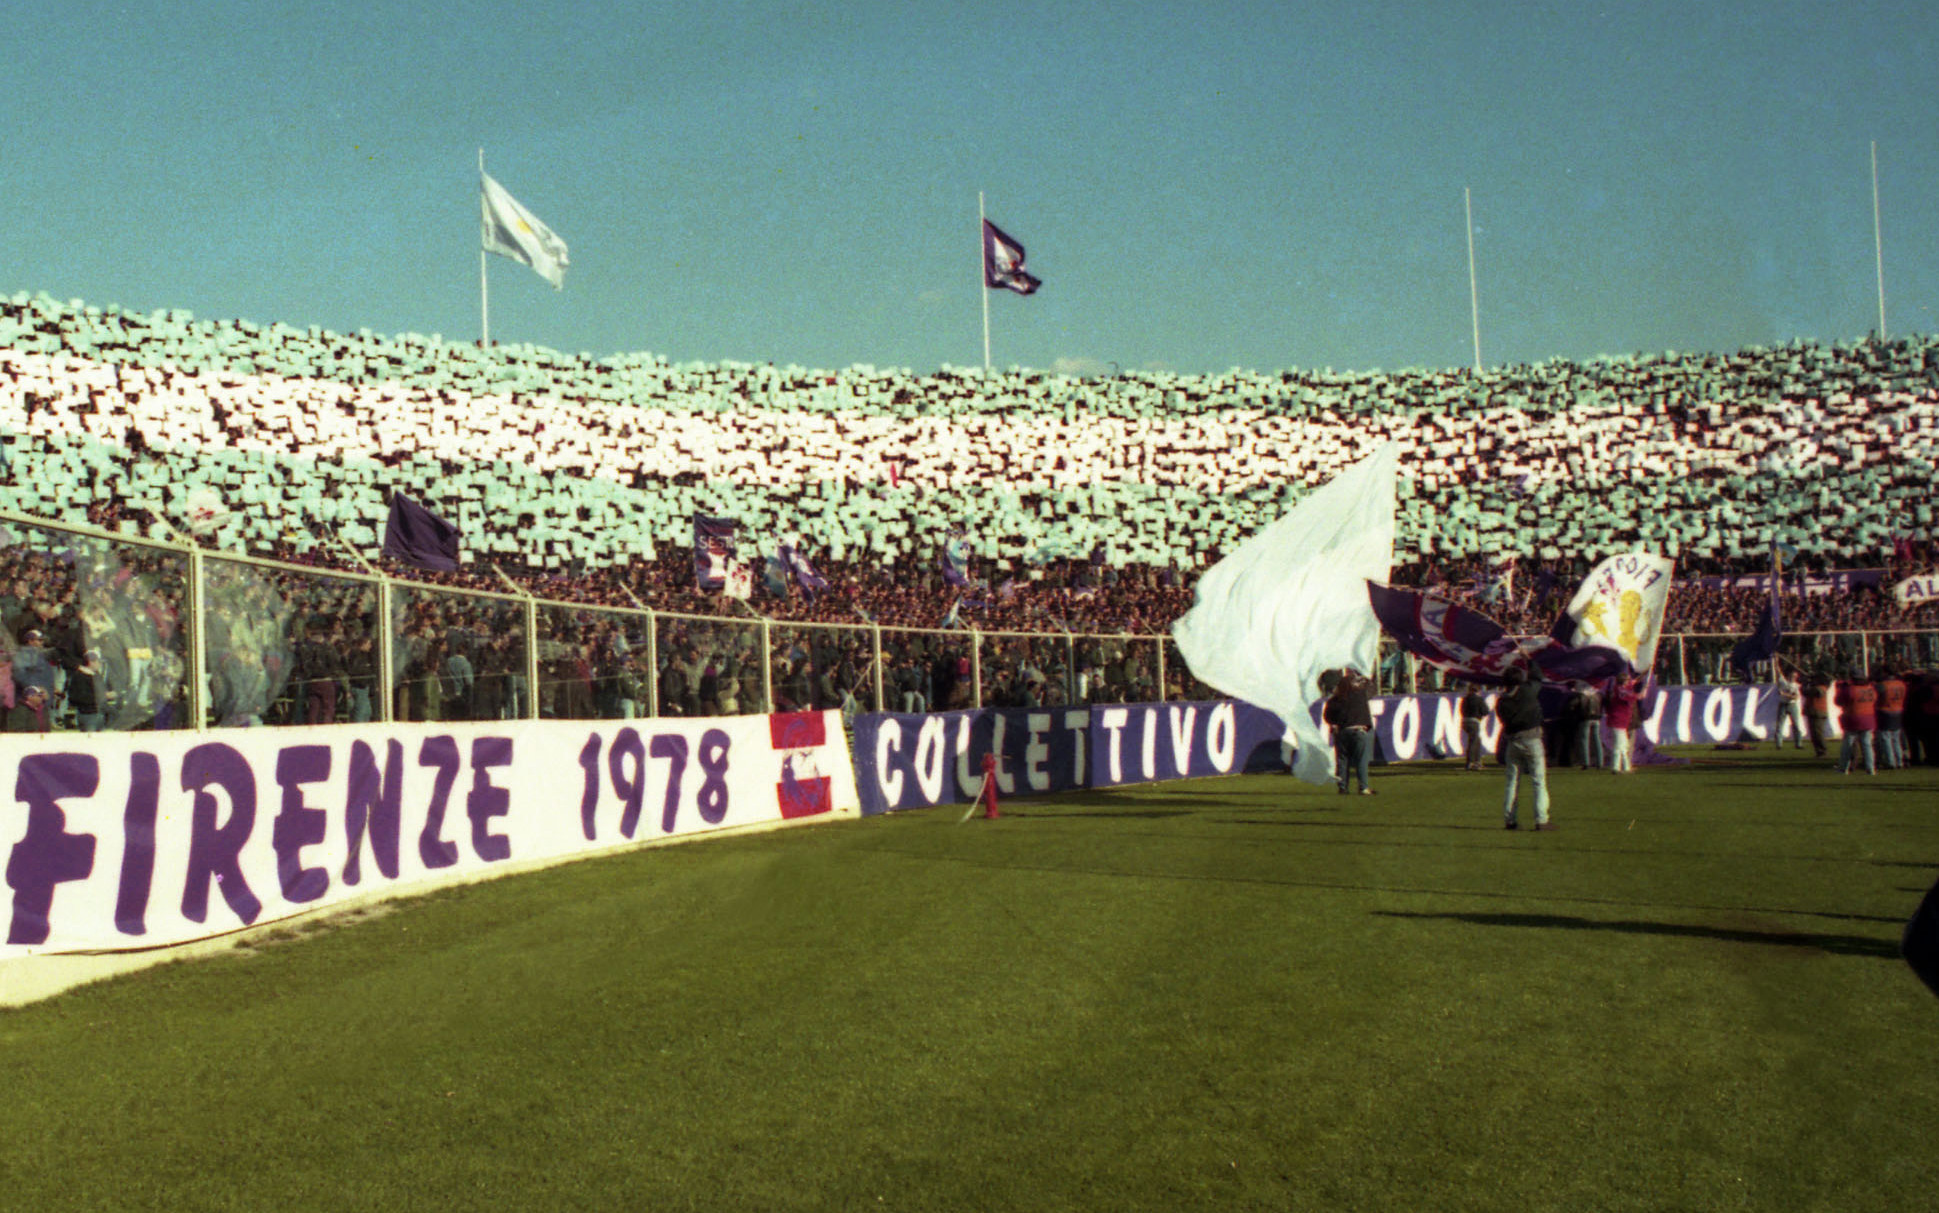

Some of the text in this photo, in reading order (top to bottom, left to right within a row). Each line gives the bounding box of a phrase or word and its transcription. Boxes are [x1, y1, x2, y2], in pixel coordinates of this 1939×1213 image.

[876, 702, 1236, 807] COLLETTIVO
[6, 727, 731, 946] FIRENZE 1978
